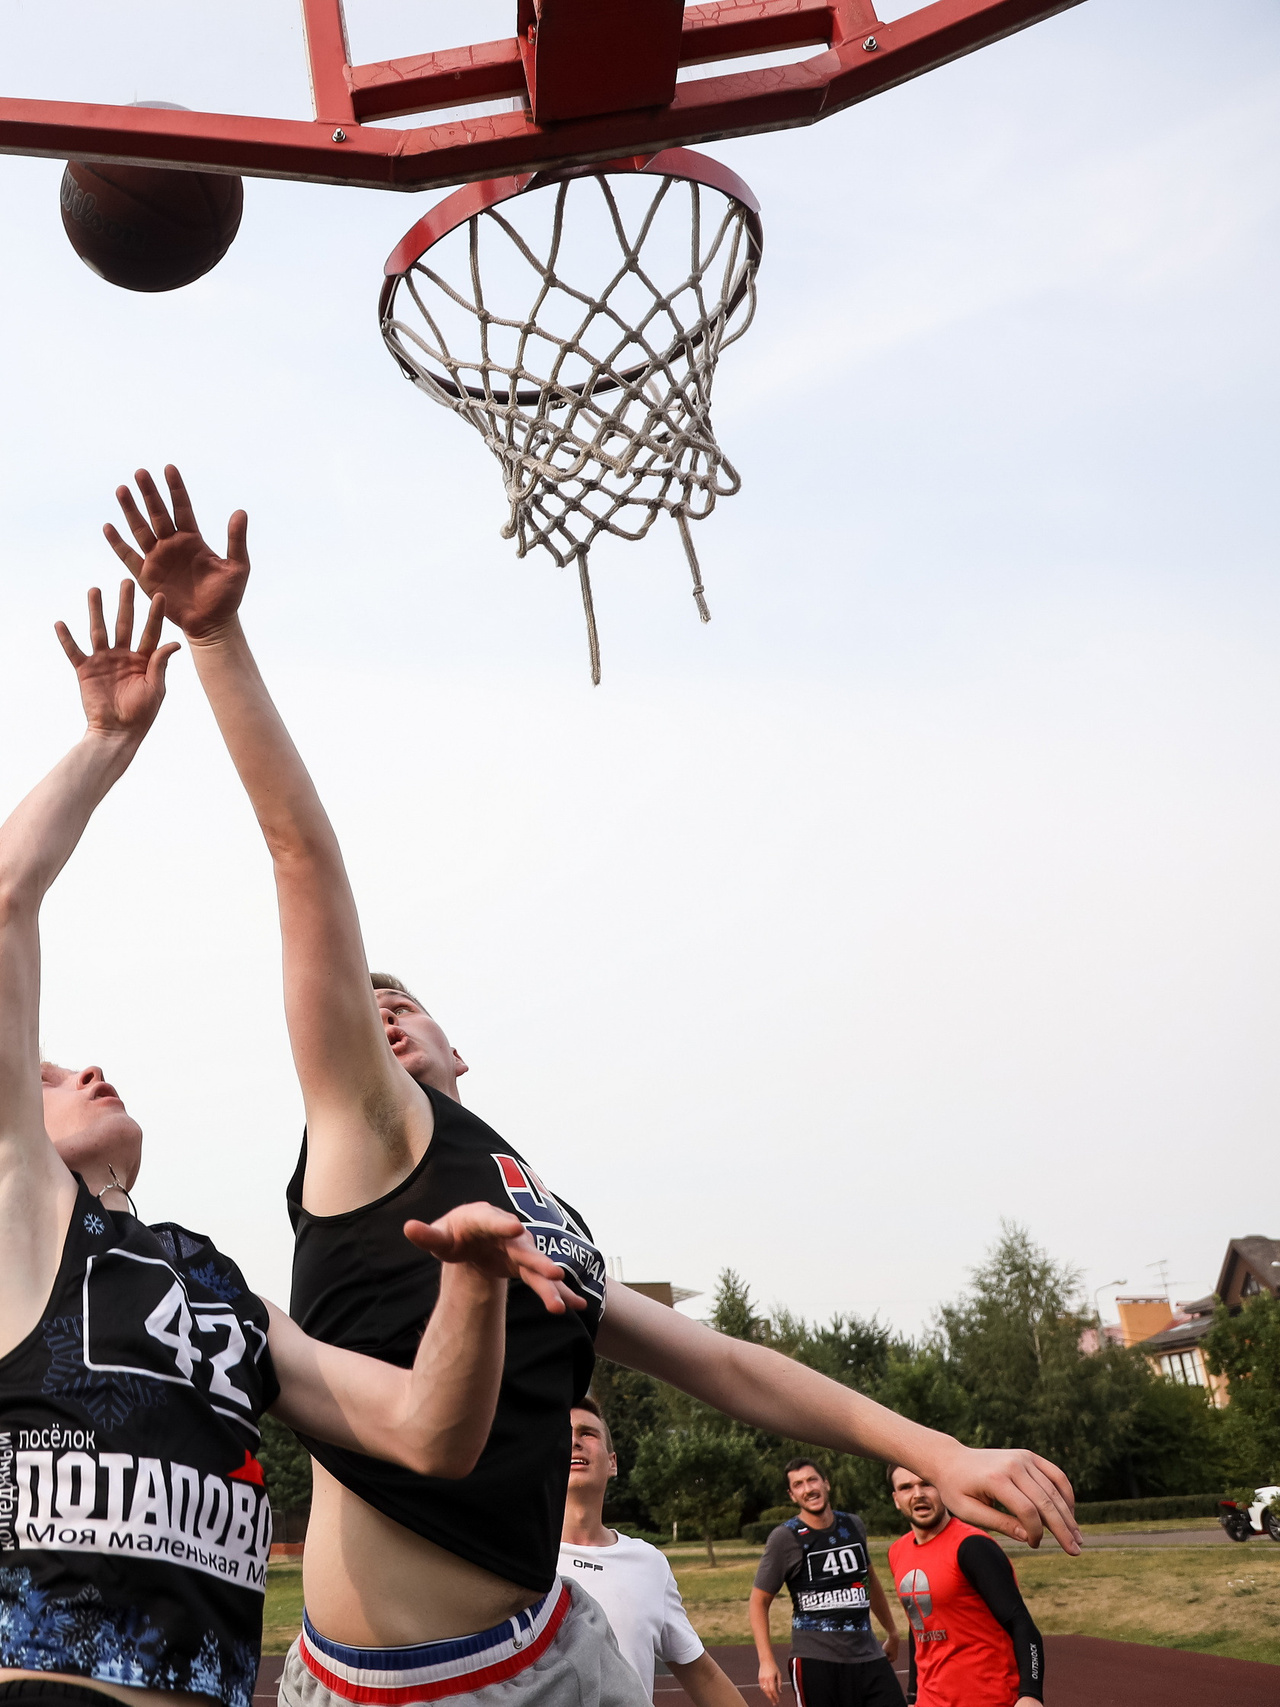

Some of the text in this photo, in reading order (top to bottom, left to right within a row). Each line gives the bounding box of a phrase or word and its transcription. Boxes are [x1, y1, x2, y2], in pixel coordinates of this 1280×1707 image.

[144, 1280, 252, 1410] 42
[19, 1423, 96, 1449] посёлок
[16, 1451, 273, 1558] ПОТАПОВО
[26, 1523, 96, 1545] Моя
[108, 1532, 239, 1577] маленькая
[573, 1559, 604, 1571] OFF
[822, 1548, 859, 1576] 40
[1029, 1643, 1039, 1680] OUTSHOCK
